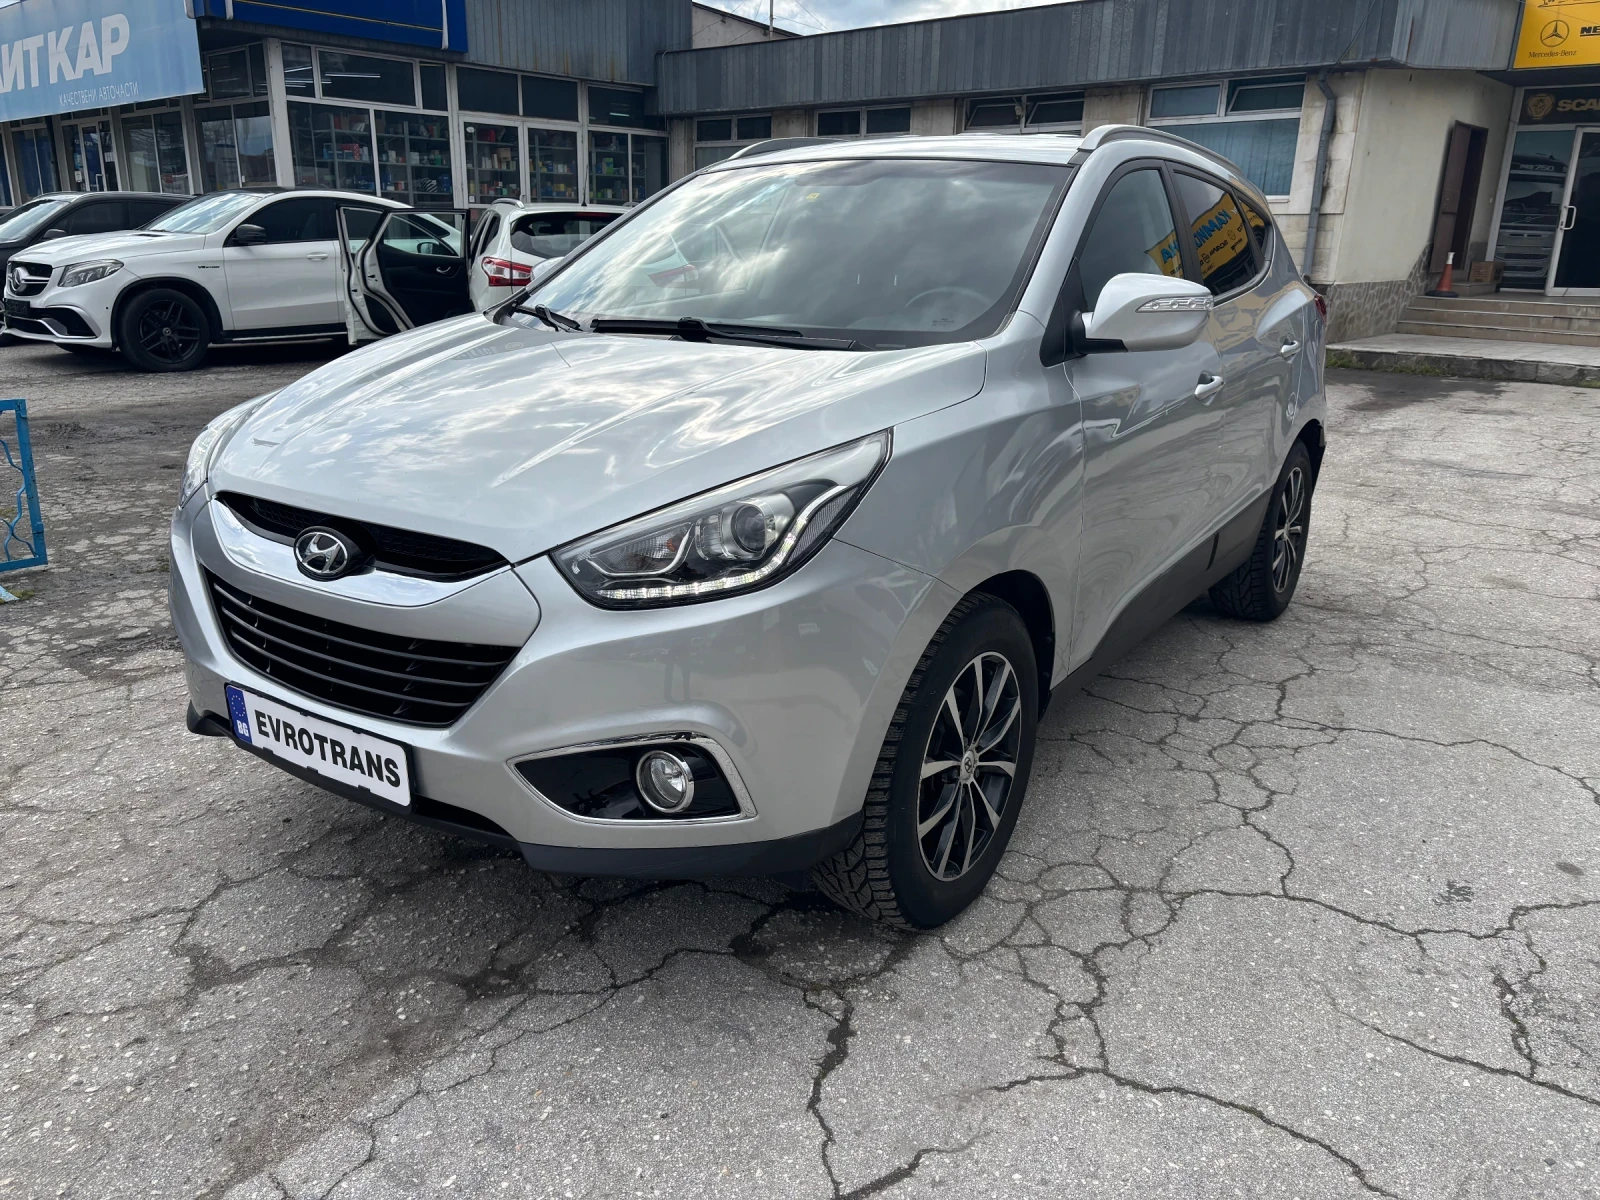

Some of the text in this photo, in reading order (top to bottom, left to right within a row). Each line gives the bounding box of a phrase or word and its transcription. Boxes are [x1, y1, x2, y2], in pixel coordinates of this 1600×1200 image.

[1528, 50, 1577, 59] Mercedes-Benz
[59, 81, 139, 107] КАЧЕСТВЕНИ АВТОЧАСТИ
[1534, 164, 1555, 172] 750
[236, 709, 401, 788] BG EVROTRANS
